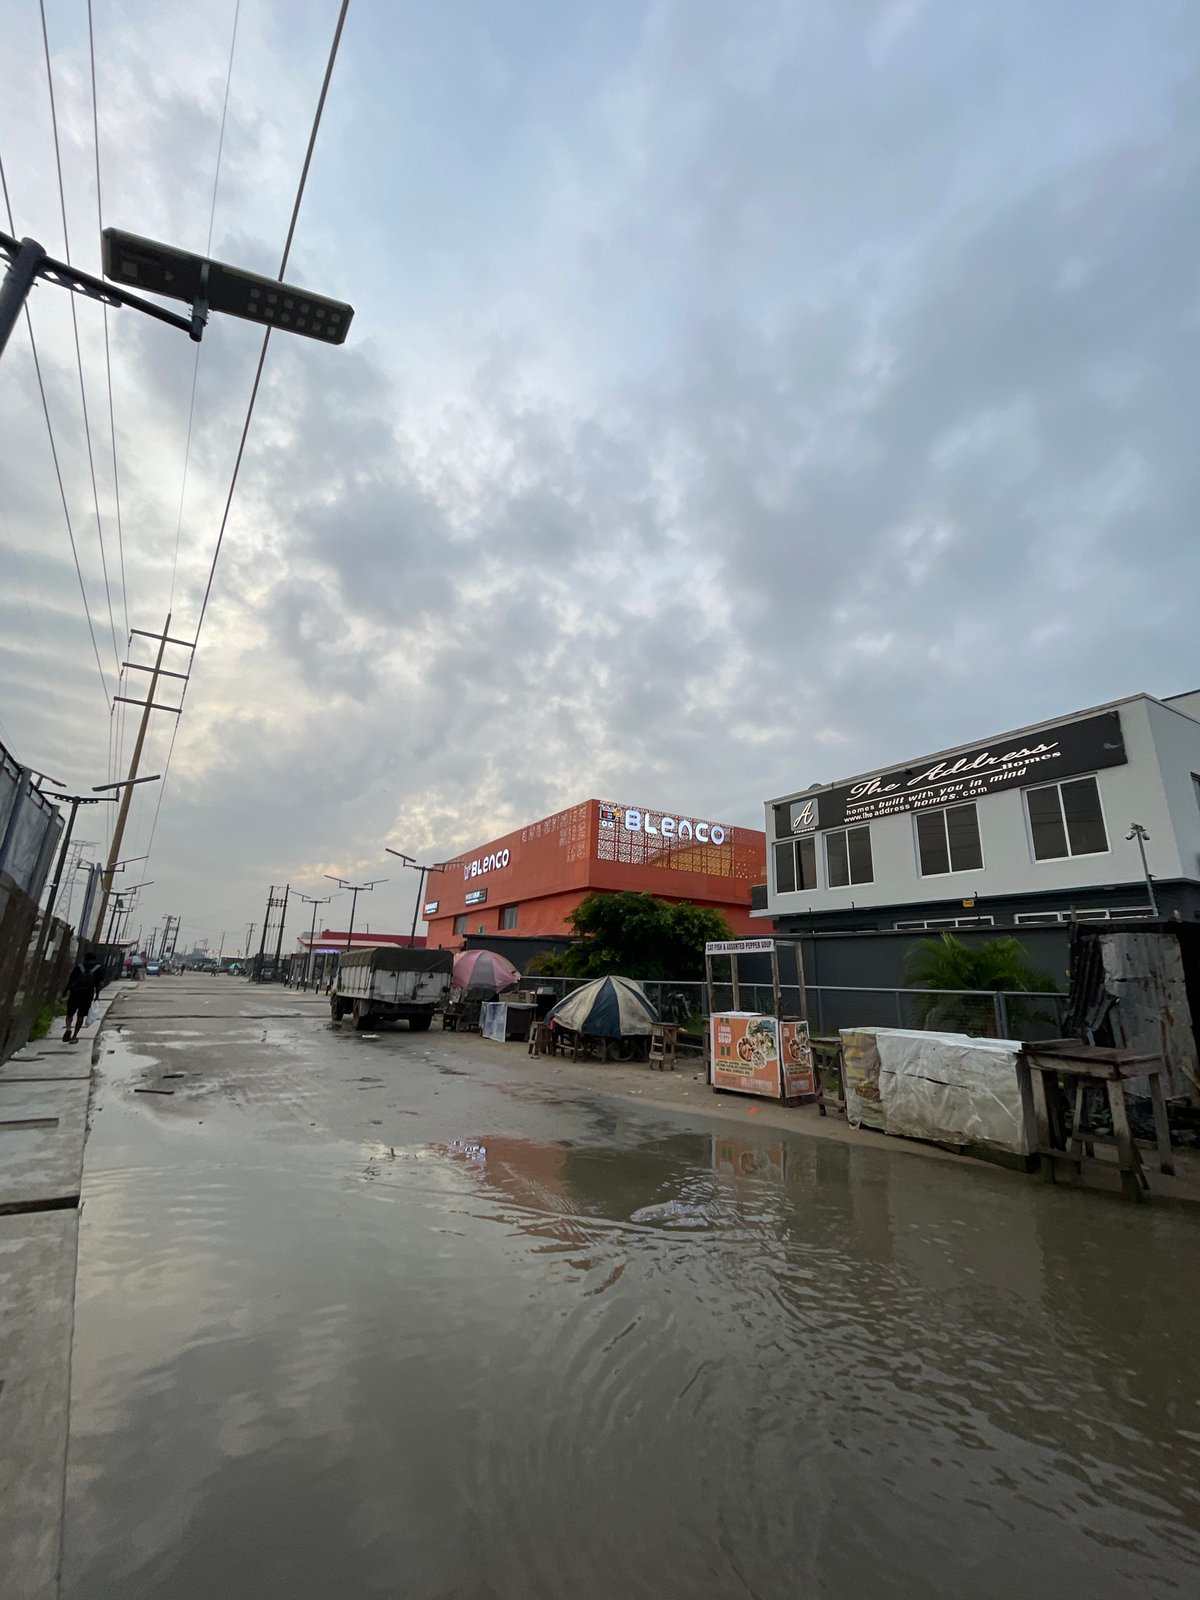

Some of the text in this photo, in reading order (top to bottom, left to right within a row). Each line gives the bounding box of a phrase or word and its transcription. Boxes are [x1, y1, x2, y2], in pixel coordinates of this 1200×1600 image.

[847, 742, 1059, 801] The Address
[1001, 751, 1061, 770] Homes
[846, 767, 1027, 816] homes built with you in mind
